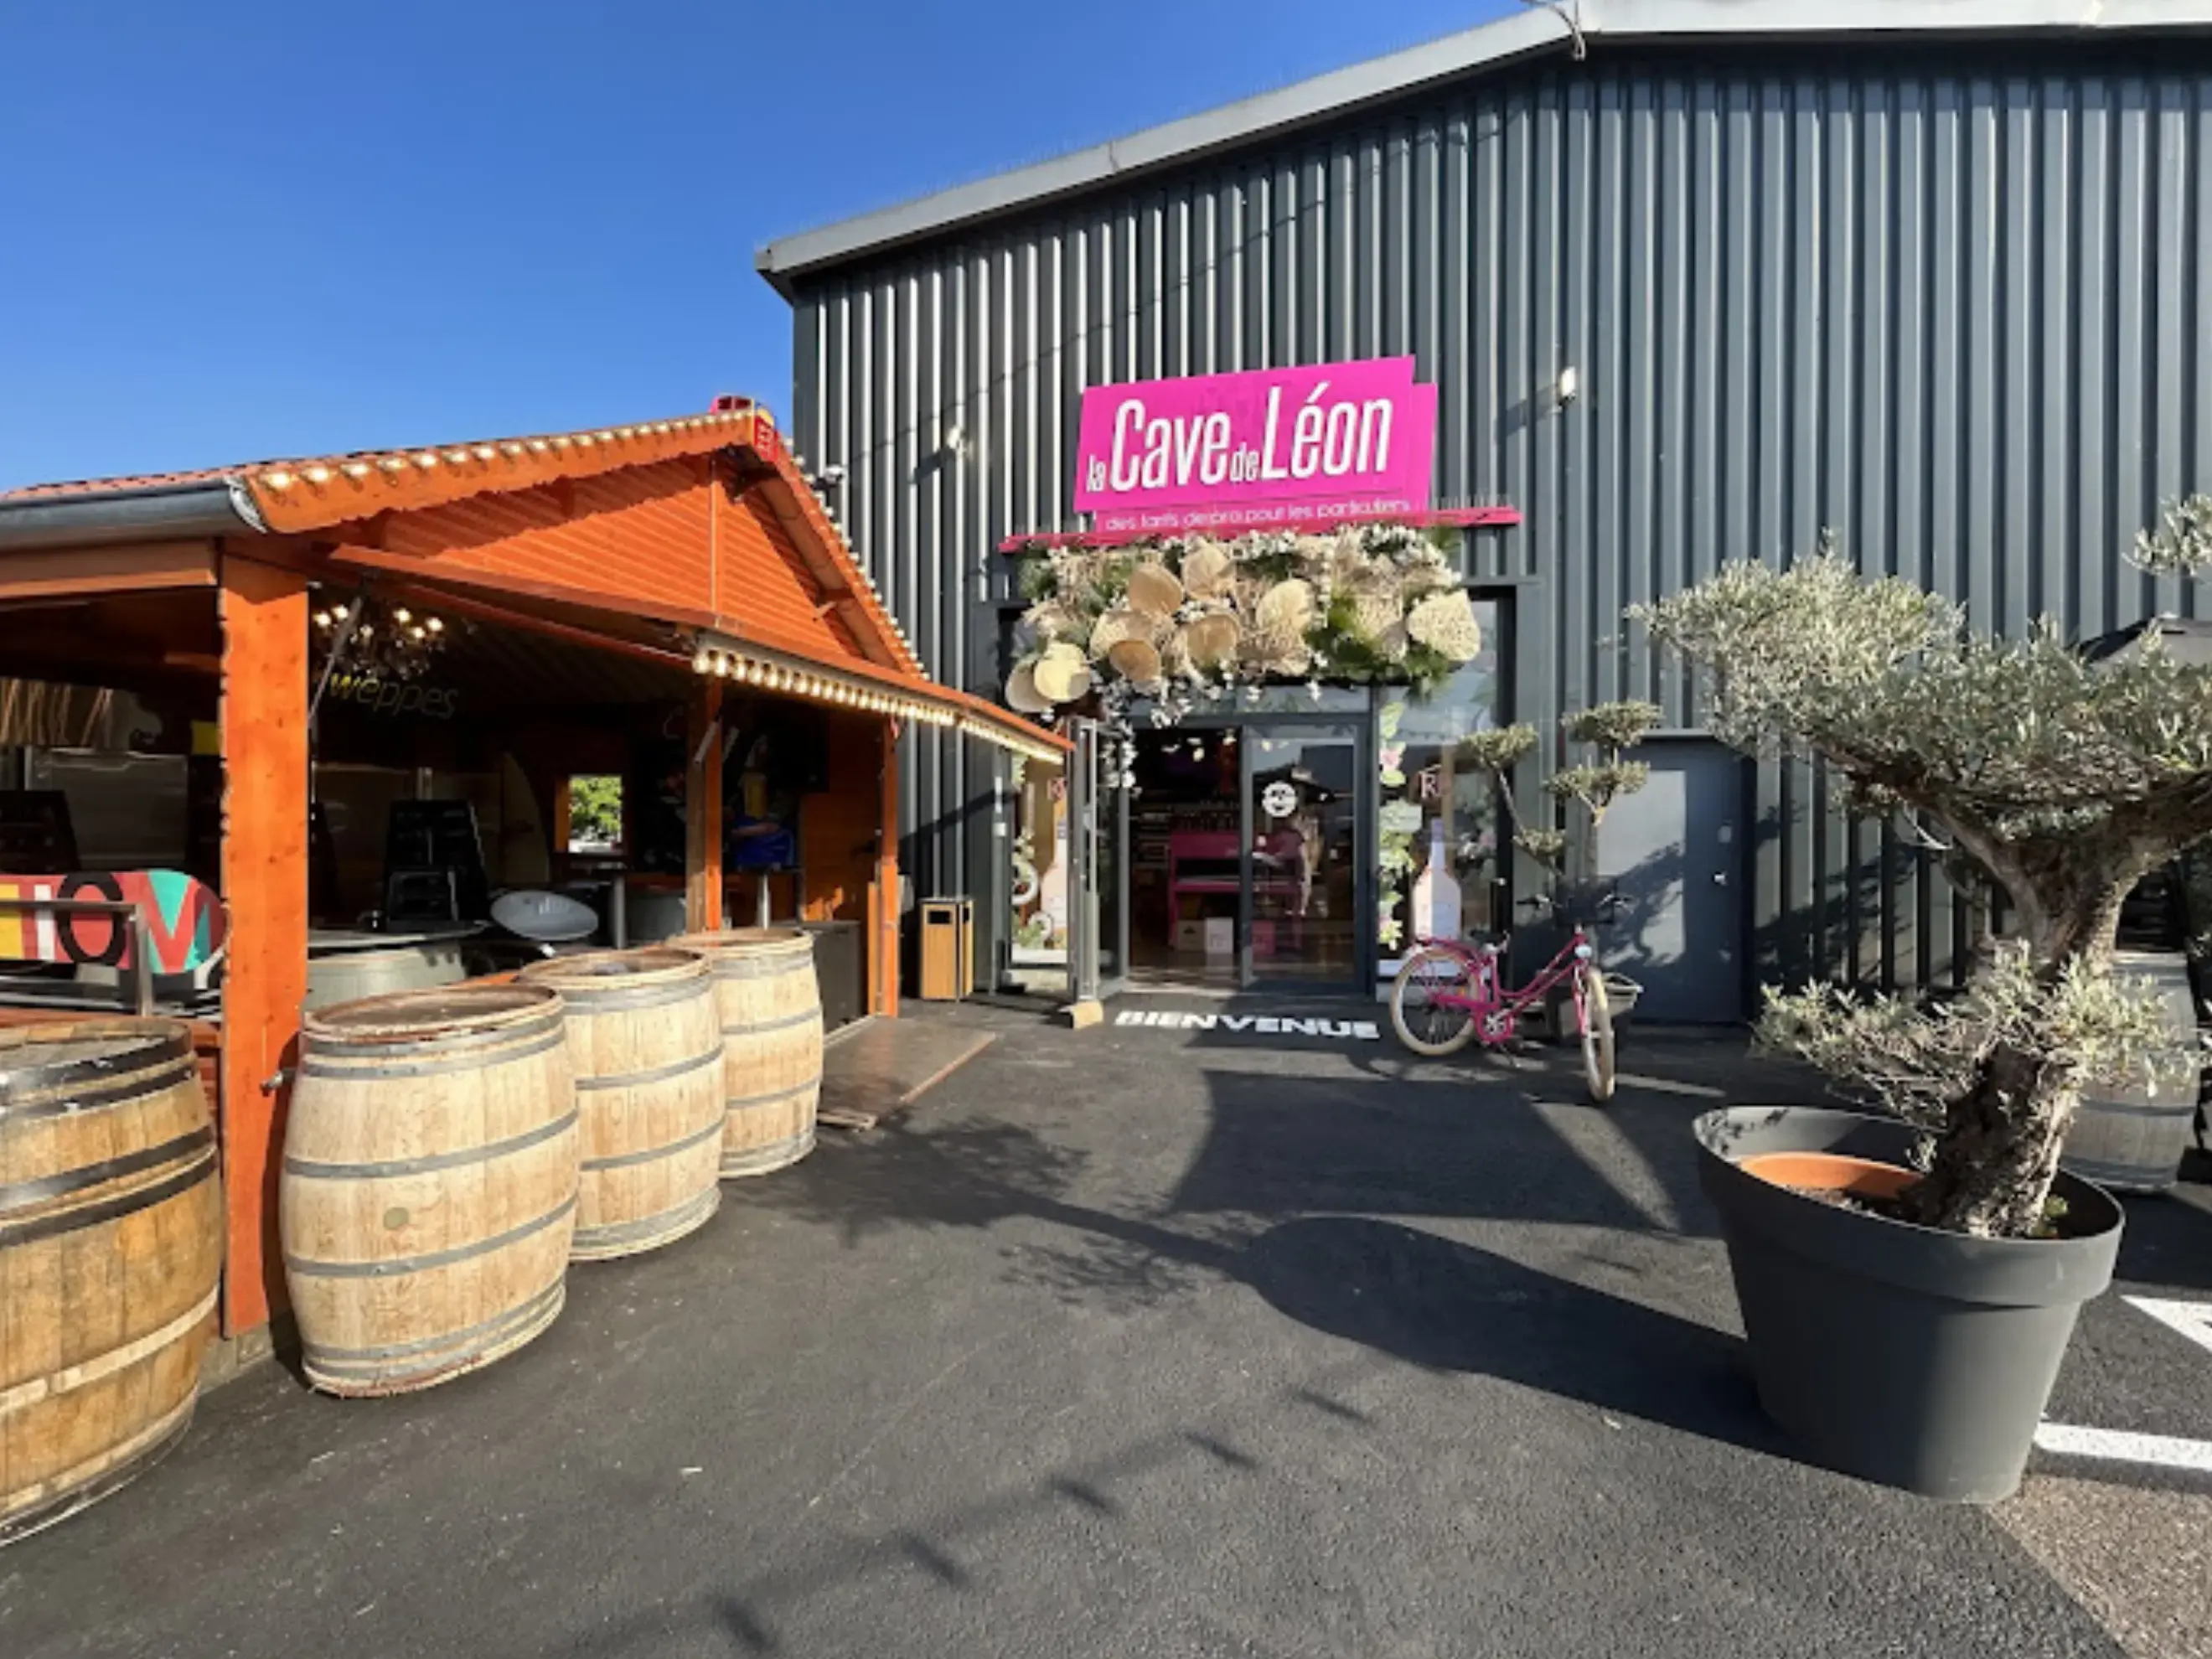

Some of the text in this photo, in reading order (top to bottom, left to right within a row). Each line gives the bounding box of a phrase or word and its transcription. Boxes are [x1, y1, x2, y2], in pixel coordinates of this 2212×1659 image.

[1086, 380, 1393, 492] la Cave de Léon
[1106, 517, 1136, 530] des
[1141, 510, 1178, 528] tarifs
[1182, 512, 1207, 527] de
[1245, 506, 1285, 523] pour
[1289, 504, 1312, 520] les
[1316, 498, 1409, 519] particuliers
[1114, 1010, 1381, 1040] BIENVENUE
